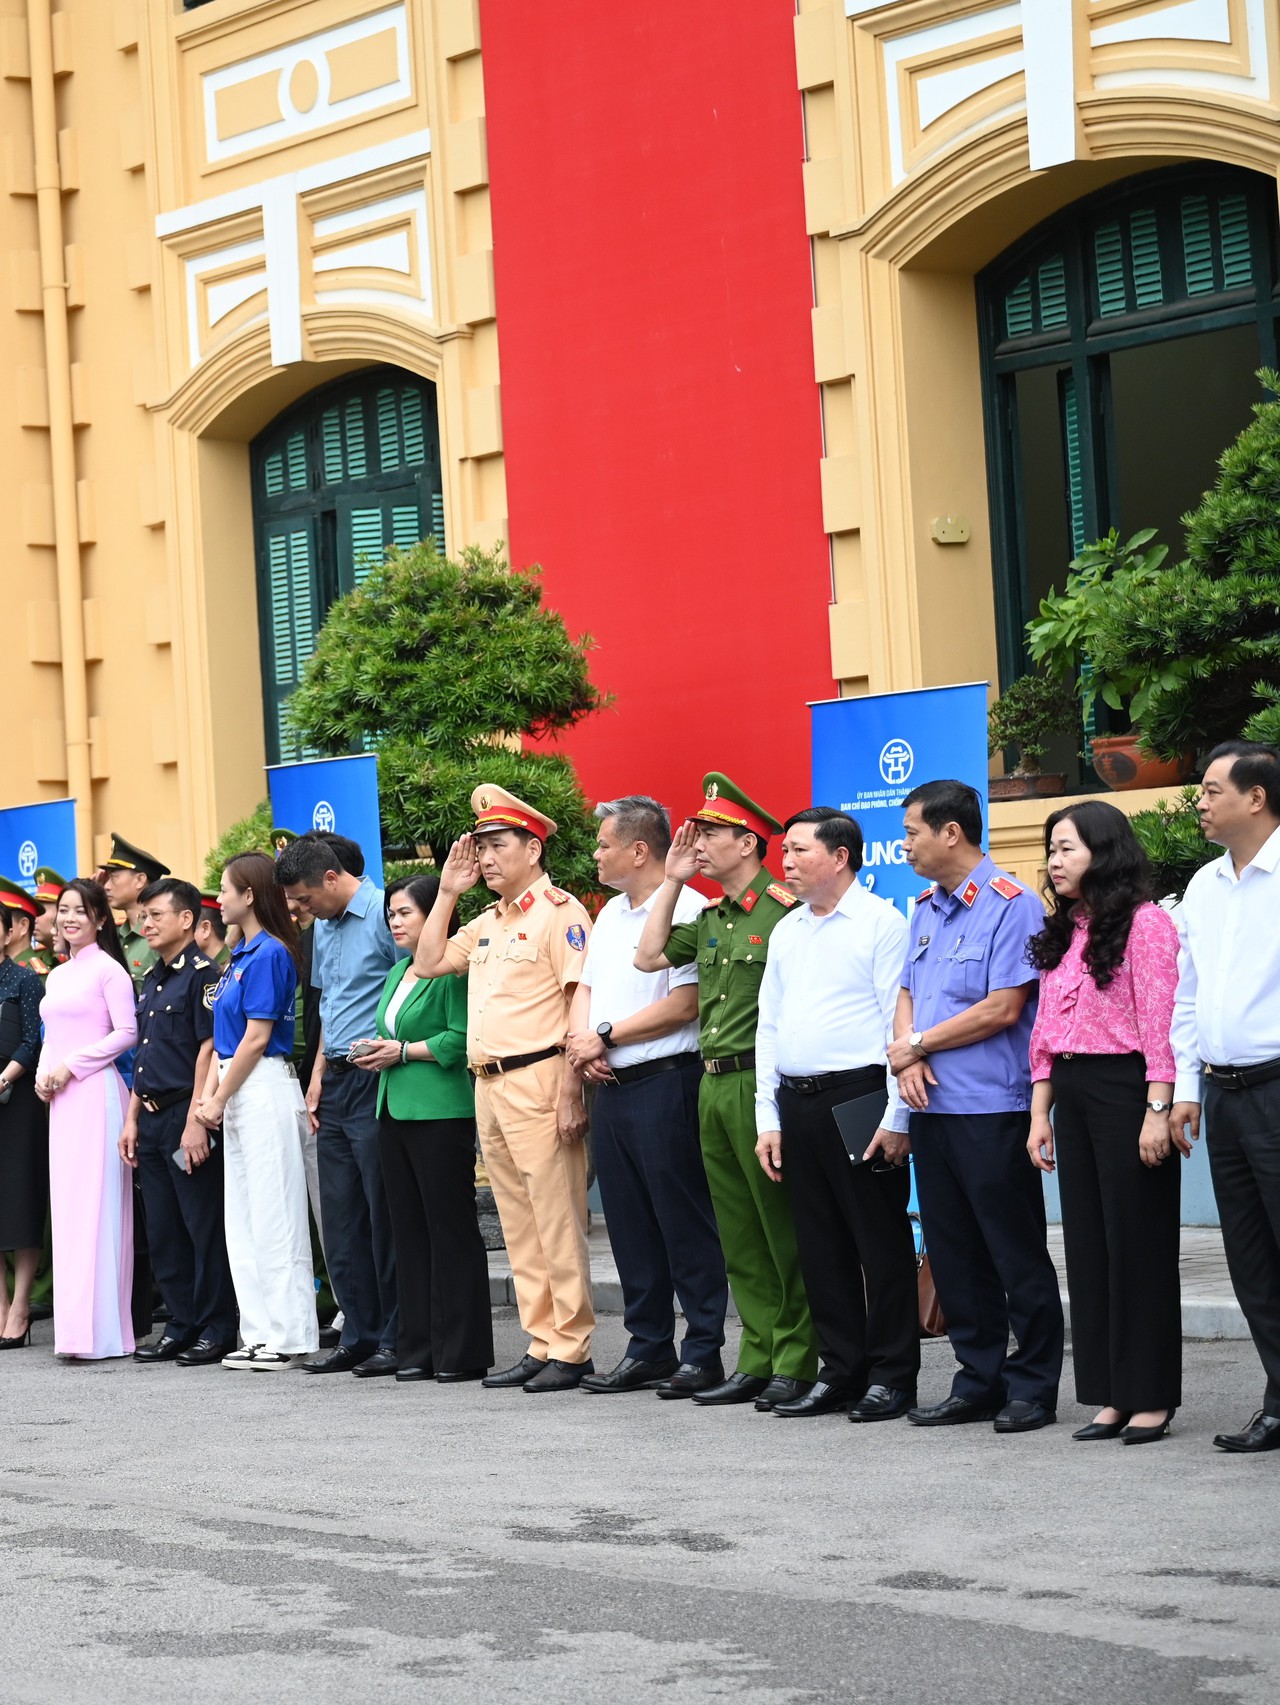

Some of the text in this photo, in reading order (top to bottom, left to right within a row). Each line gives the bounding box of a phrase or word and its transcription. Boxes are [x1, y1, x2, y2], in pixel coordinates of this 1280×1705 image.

[864, 791, 873, 799] BAN
[873, 788, 886, 798] NHÂN
[886, 788, 895, 797] DÂN
[840, 803, 851, 811] BAN
[861, 801, 871, 811] ĐẠO
[862, 839, 908, 867] UNG
